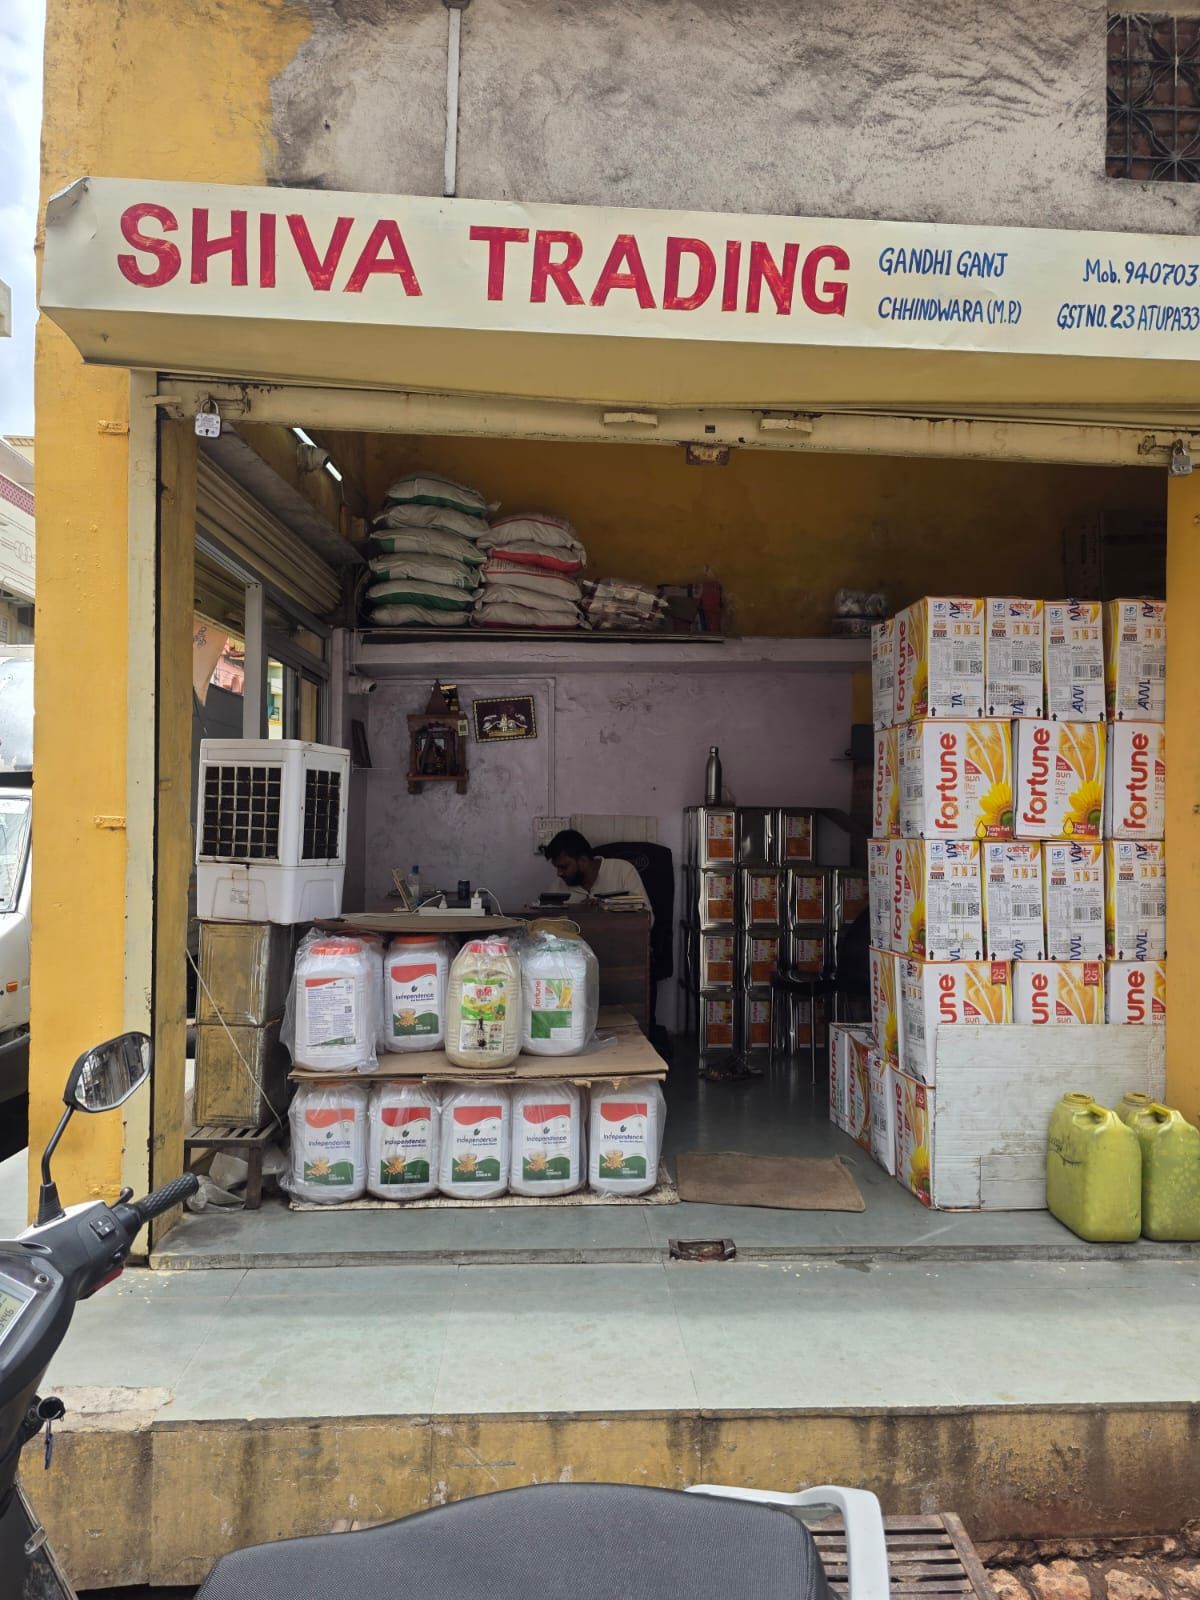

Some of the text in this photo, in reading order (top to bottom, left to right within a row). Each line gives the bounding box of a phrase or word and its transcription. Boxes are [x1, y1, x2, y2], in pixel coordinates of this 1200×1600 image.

[117, 202, 851, 318] SHIVA TRADING
[879, 247, 1009, 278] GANDHI GANJ
[878, 296, 984, 323] CHHINDWARA
[896, 620, 906, 712] fortune
[875, 740, 884, 826] fortune
[934, 732, 959, 829] fortune
[1022, 727, 1050, 824] fortune
[1122, 732, 1149, 829] fortune
[893, 847, 903, 941] fortune
[992, 968, 1006, 981] 25
[1084, 969, 1098, 981] 25
